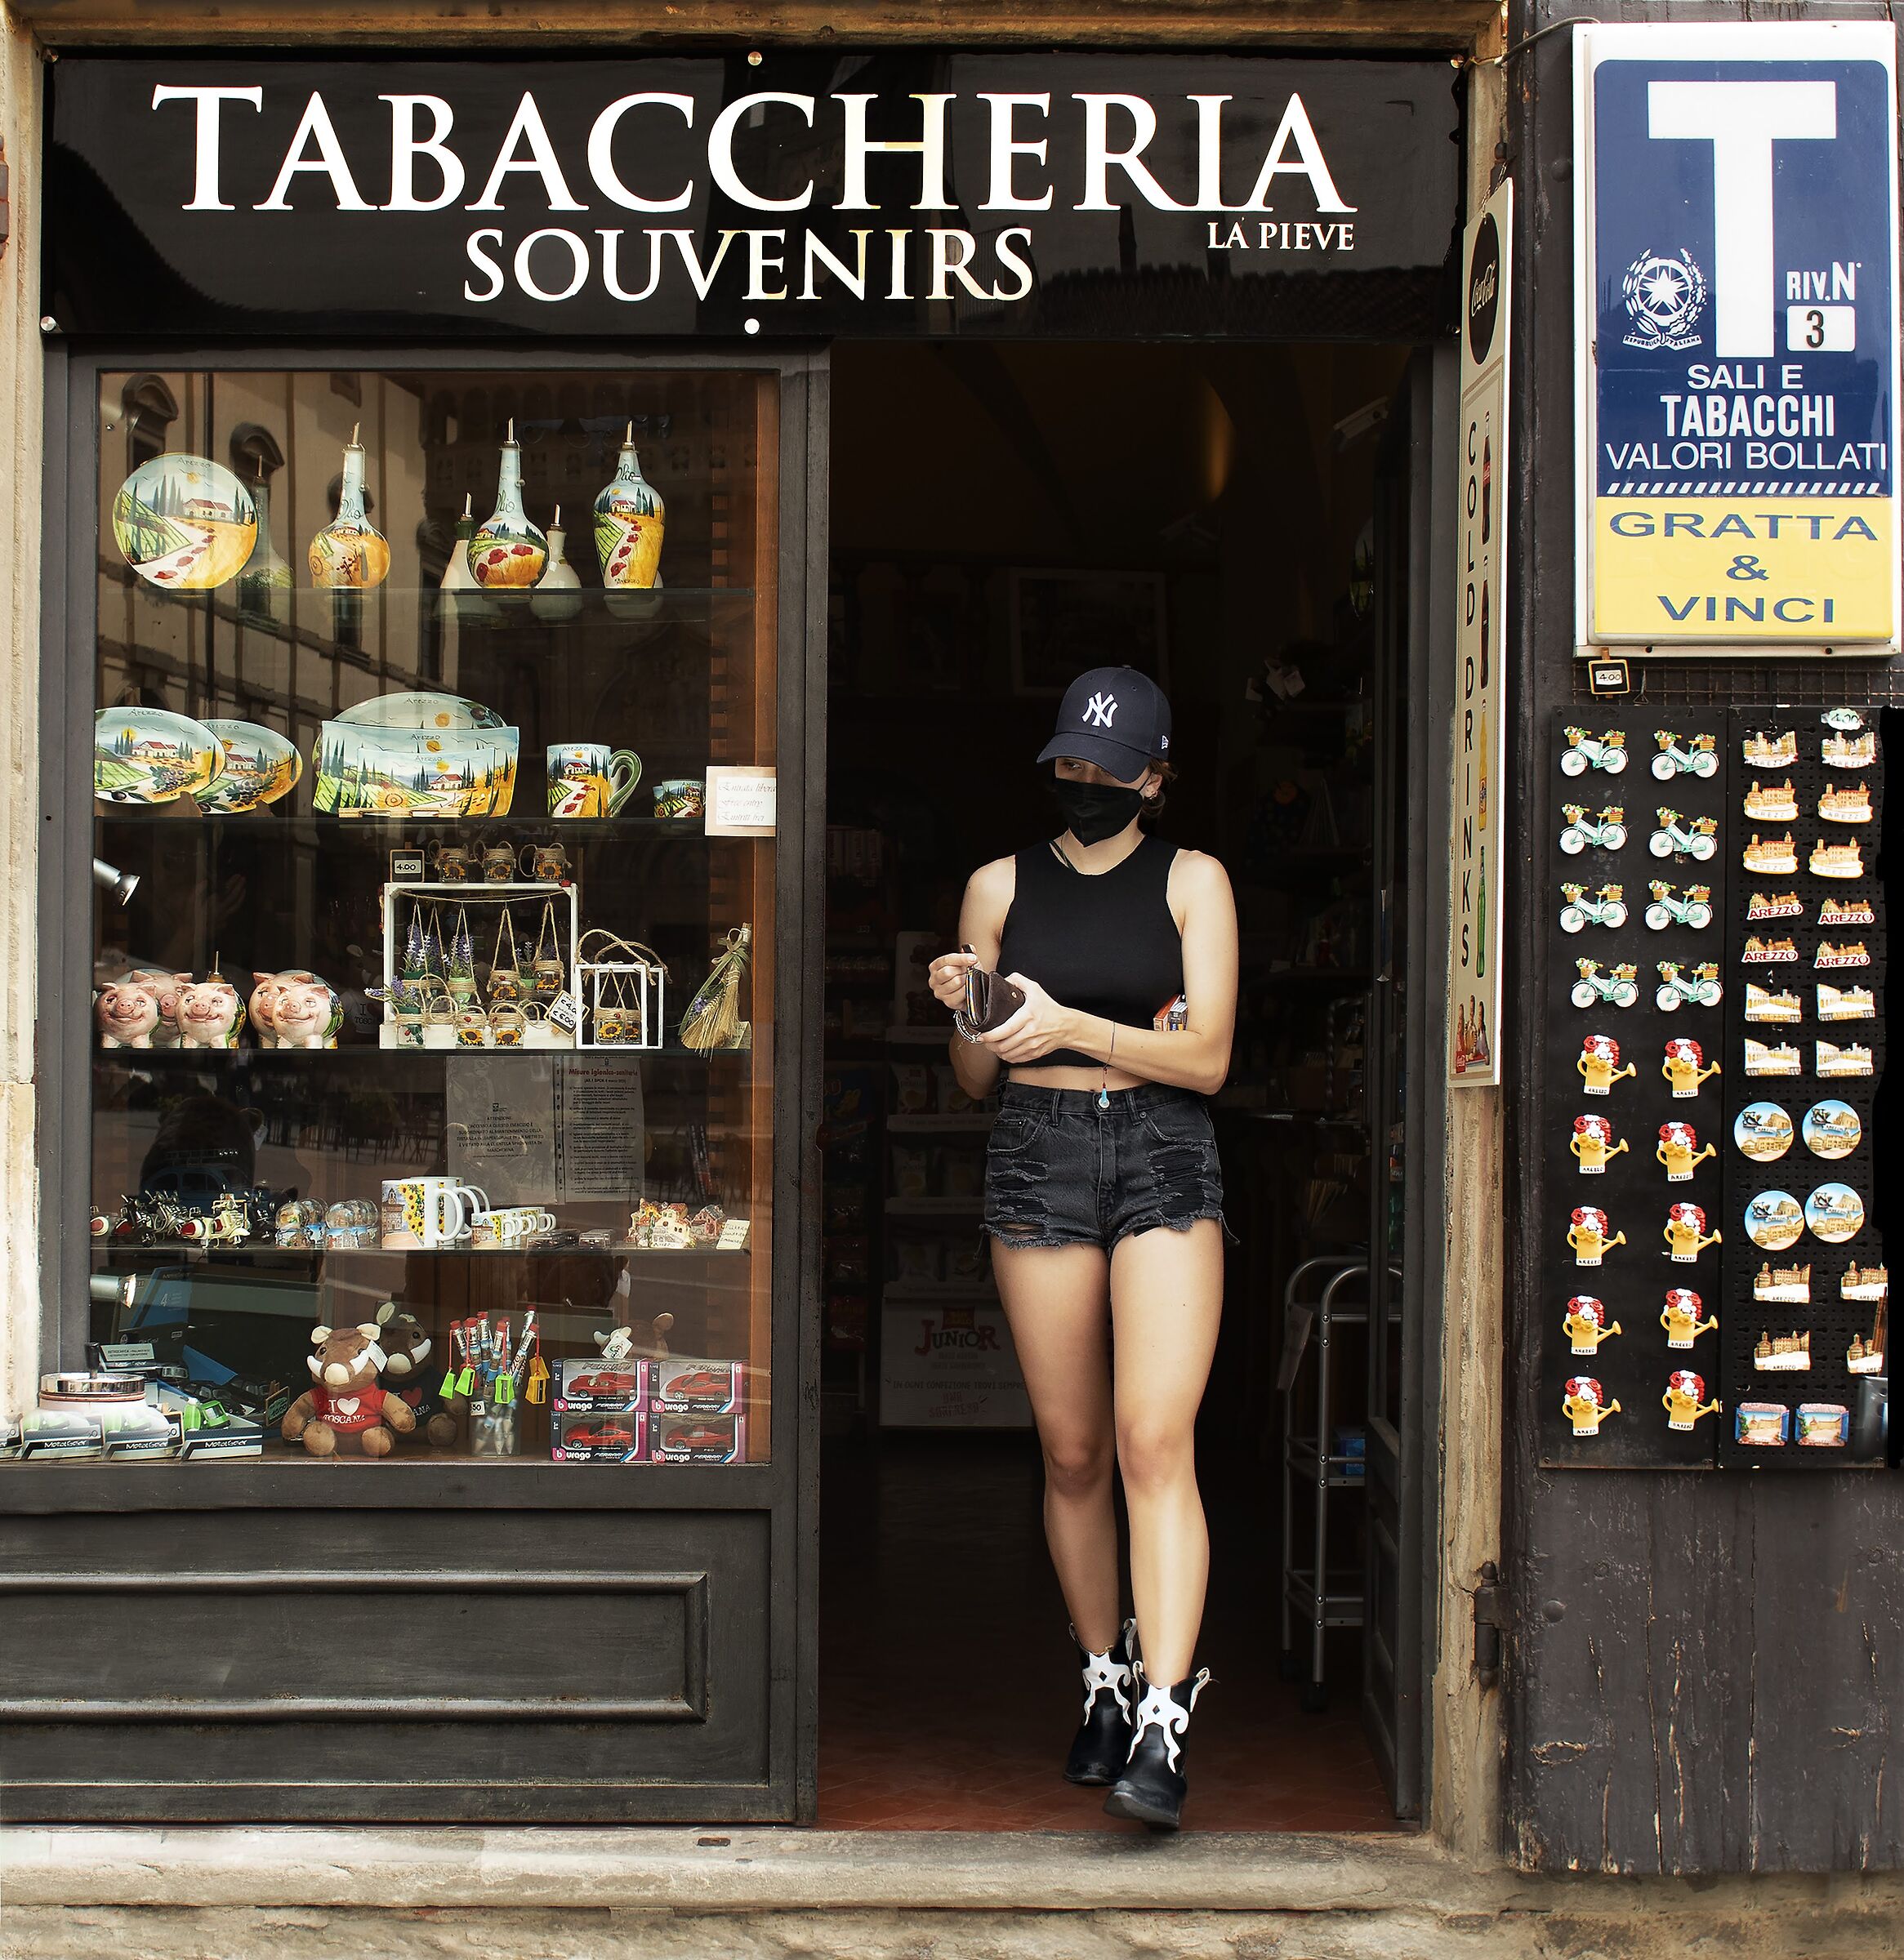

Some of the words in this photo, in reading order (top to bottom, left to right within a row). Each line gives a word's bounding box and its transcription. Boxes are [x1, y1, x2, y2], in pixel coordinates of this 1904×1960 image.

[151, 84, 1358, 213] TABACCHERIA
[1648, 81, 1837, 358] T
[1207, 221, 1250, 250] LA
[1258, 222, 1355, 251] PIEVE
[464, 227, 1033, 302] SOUVENIRS
[1666, 336, 1701, 347] ITALIANA
[1806, 310, 1825, 349] 3
[1687, 364, 1764, 390] SALI
[1781, 364, 1804, 390] E
[1660, 394, 1835, 439] TABACCHI
[1605, 442, 1732, 471] VALORI
[1746, 441, 1888, 471] BOLLATI
[1465, 421, 1477, 627] COLD
[1609, 511, 1879, 542] GRATTA
[1726, 555, 1770, 581] &
[1657, 596, 1835, 625] VINCI
[1460, 655, 1474, 969] DRINKS
[395, 862, 417, 871] 4.00
[1749, 903, 1803, 919] AREZZO
[1820, 913, 1874, 924] AREZZO
[1744, 951, 1798, 962] AREZZO
[1816, 956, 1870, 969] AREZZO
[322, 1414, 366, 1424] TOSCANA
